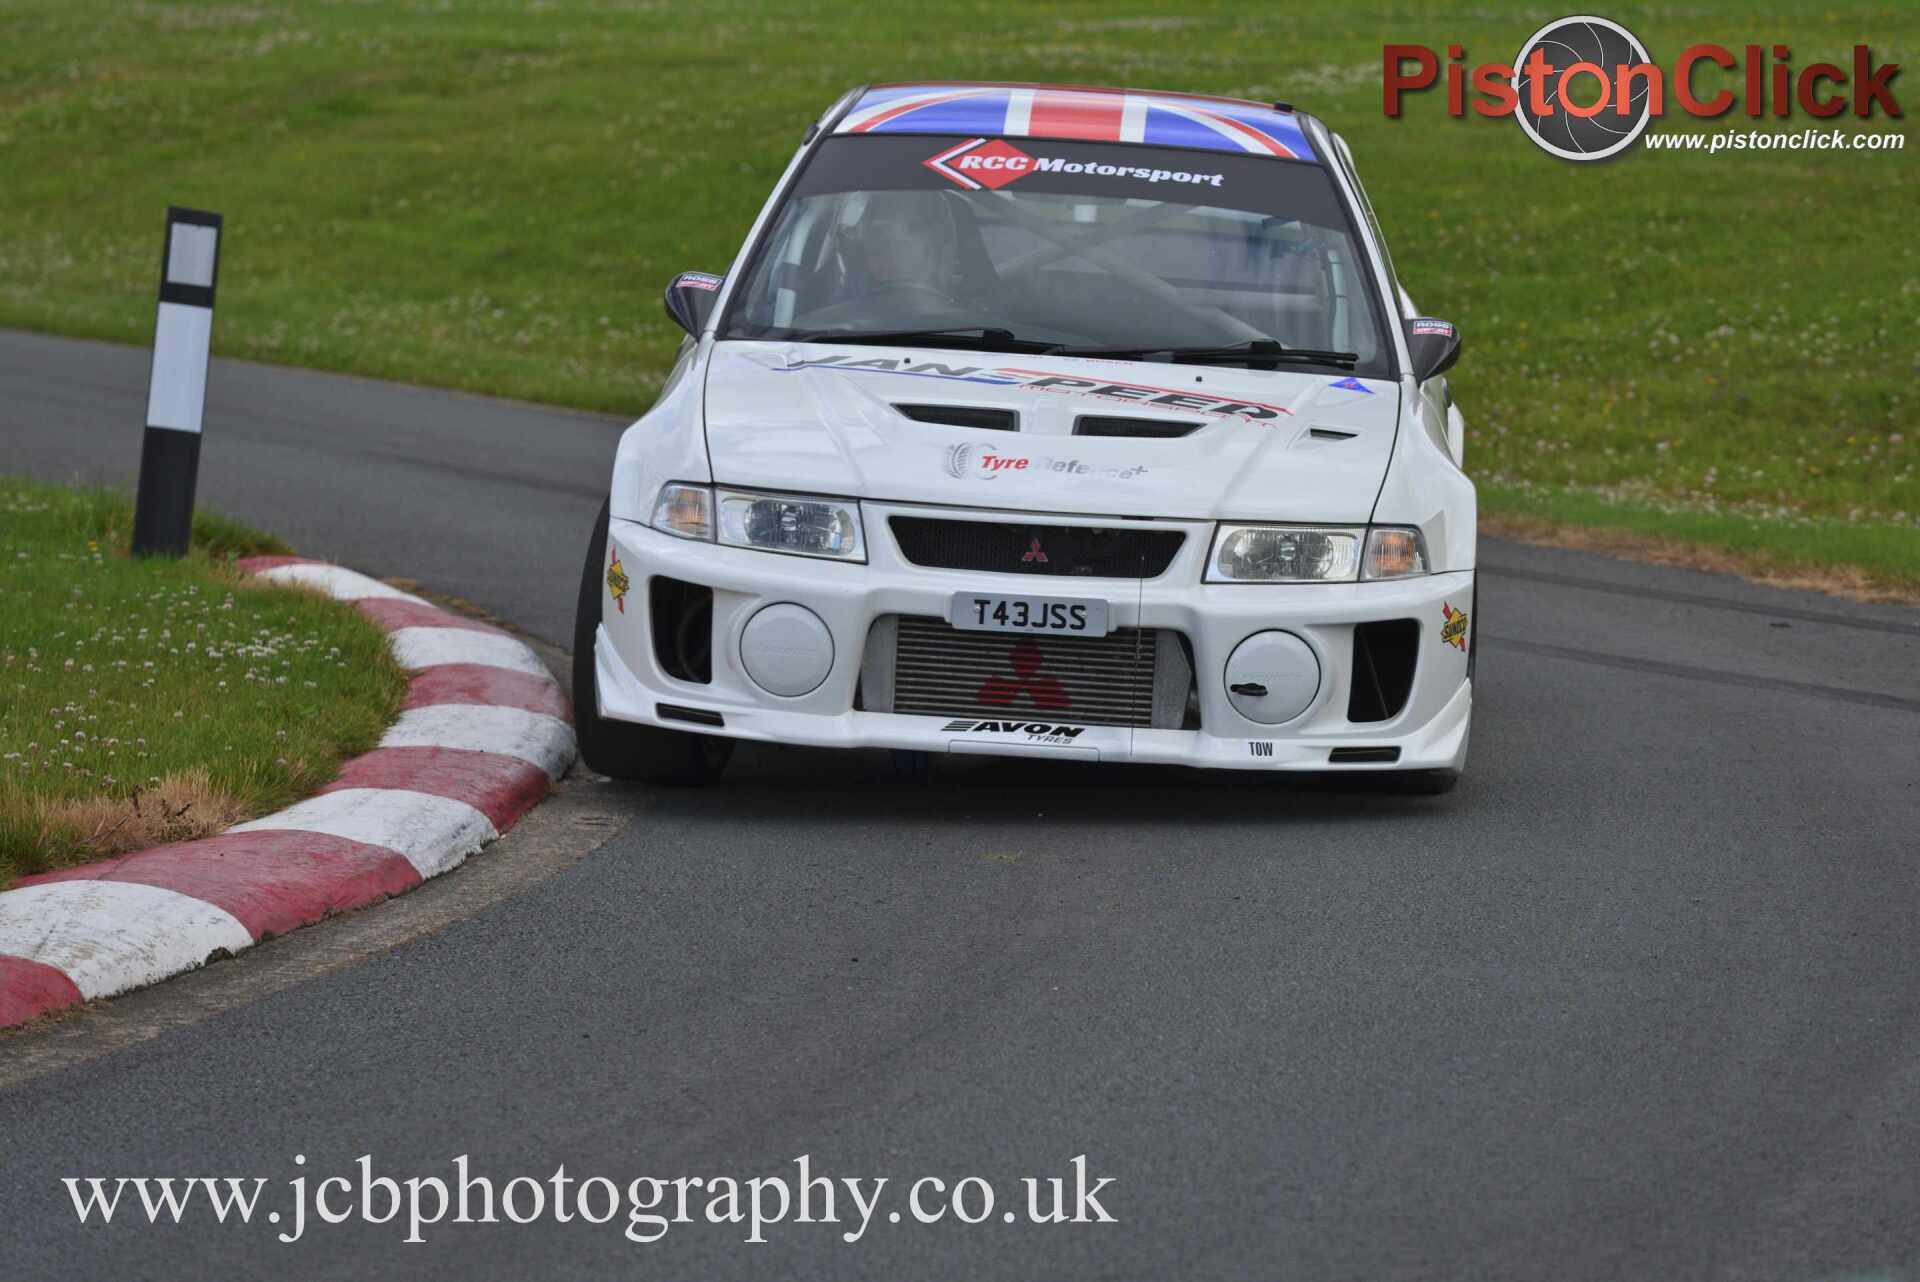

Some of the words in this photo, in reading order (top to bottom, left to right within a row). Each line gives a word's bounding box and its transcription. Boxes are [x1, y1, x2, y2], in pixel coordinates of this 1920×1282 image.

[1032, 156, 1226, 188] Motorsport
[981, 455, 1030, 471] Tyre
[973, 599, 1087, 631] T43JSS
[972, 721, 1086, 738] AVON
[1027, 734, 1073, 745] TYRES
[1249, 741, 1274, 757] TOW
